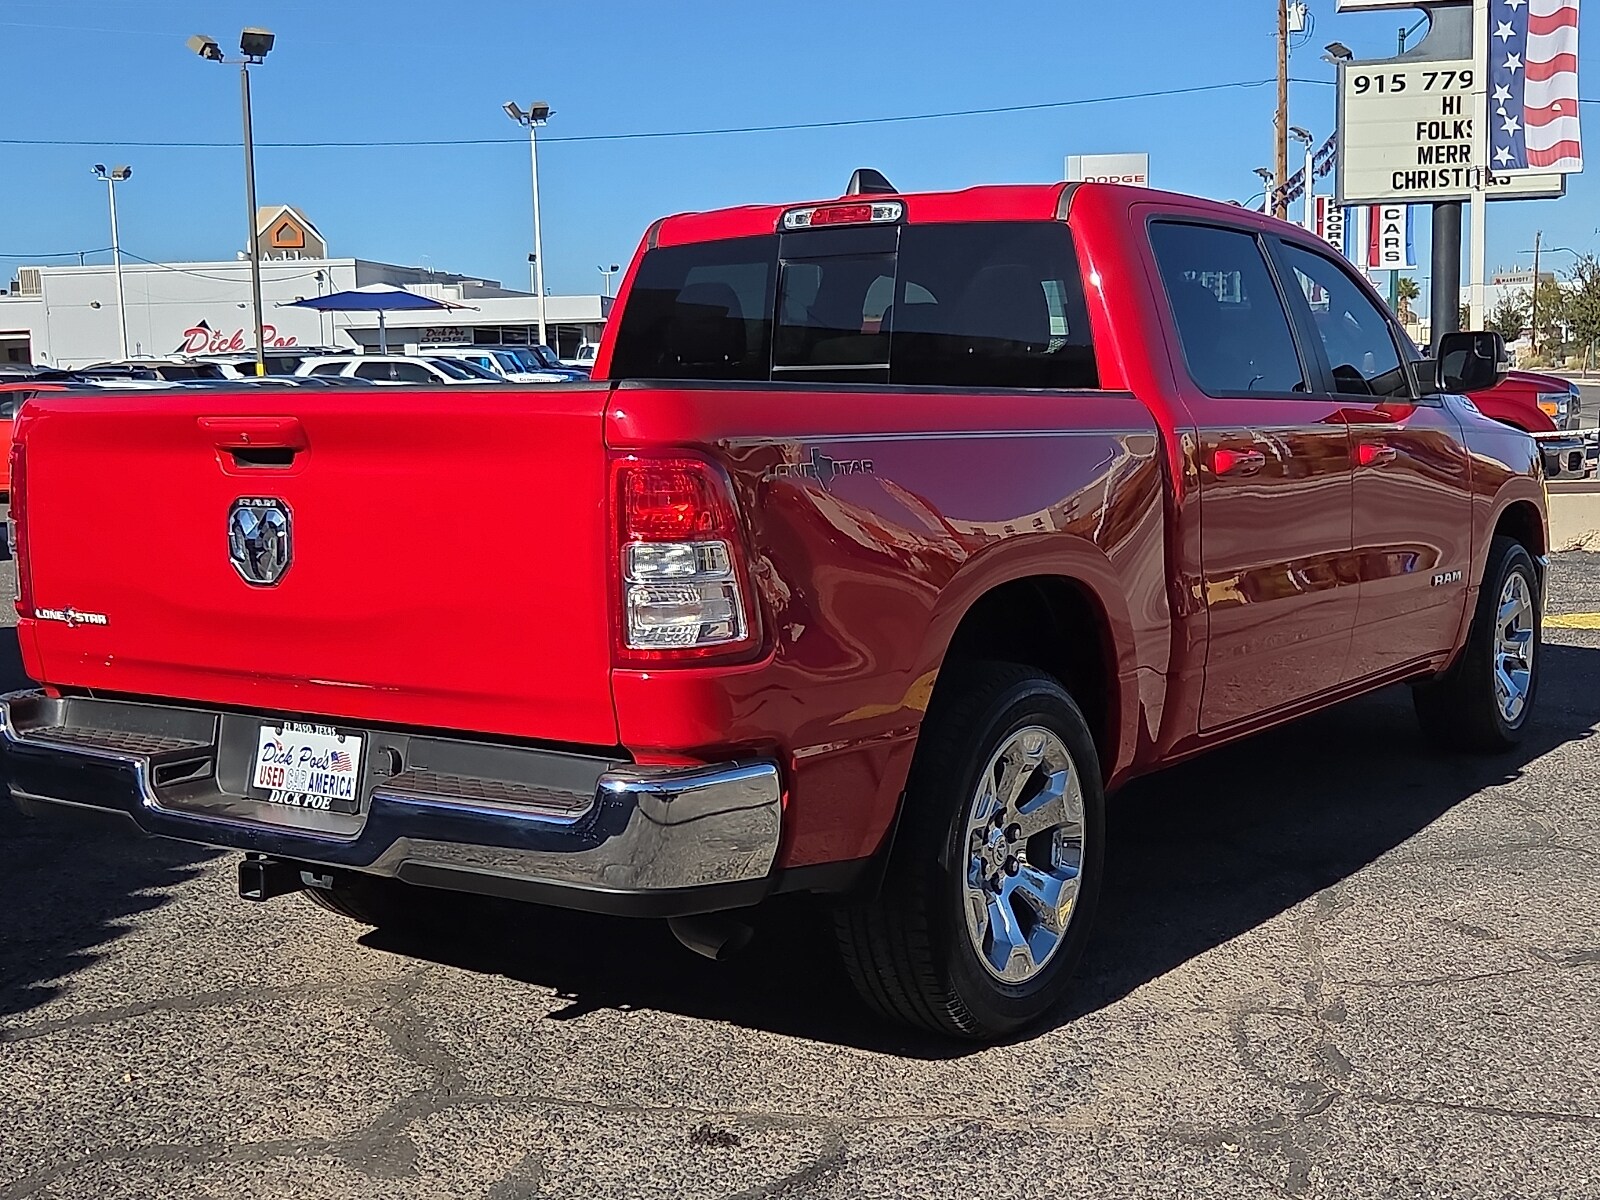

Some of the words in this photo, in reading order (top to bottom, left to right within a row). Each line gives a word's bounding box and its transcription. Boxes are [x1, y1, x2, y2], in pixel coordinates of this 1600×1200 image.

[1354, 73, 1407, 95] 915
[1422, 70, 1473, 91] 779
[1442, 95, 1462, 115] HI
[1085, 175, 1145, 184] DODGE
[1392, 166, 1511, 190] CHRIST
[1326, 199, 1343, 253] PROGRA
[1384, 209, 1401, 262] CARS
[1501, 276, 1529, 284] MARRIOTT
[184, 328, 246, 353] Dick
[238, 498, 277, 507] RAM
[1434, 570, 1463, 587] RAM
[35, 608, 65, 621] LONE
[75, 613, 107, 625] STAR
[283, 722, 293, 731] EL
[315, 725, 337, 736] TEXAS
[262, 742, 295, 766] Dick
[297, 747, 330, 770] Poe's
[259, 765, 285, 788] USED
[307, 772, 352, 798] AMERICA
[269, 790, 304, 806] DICK
[302, 794, 333, 810] POE
